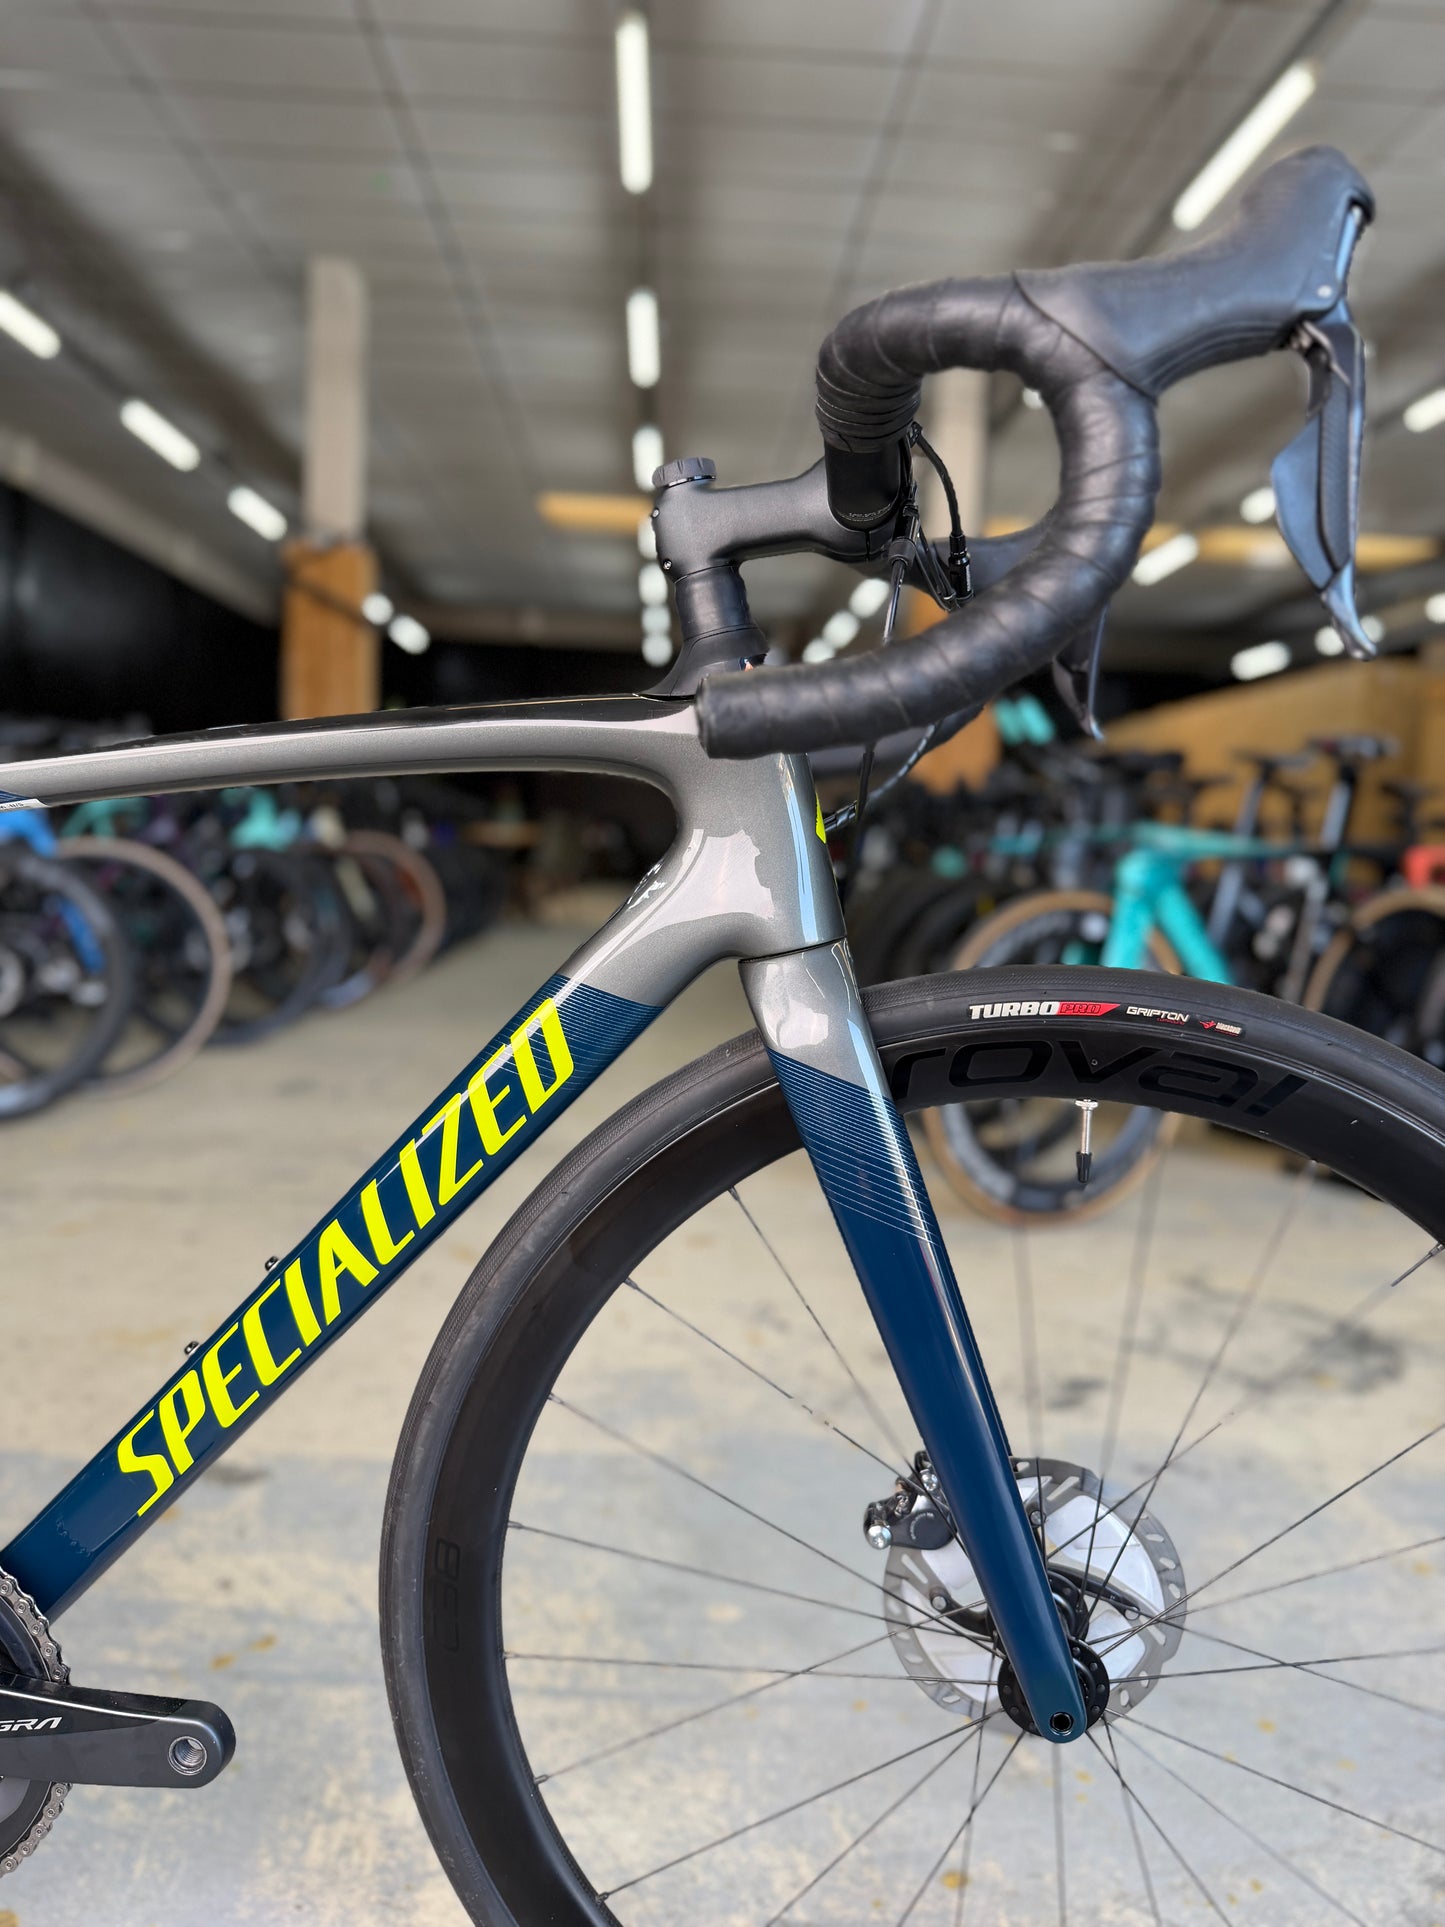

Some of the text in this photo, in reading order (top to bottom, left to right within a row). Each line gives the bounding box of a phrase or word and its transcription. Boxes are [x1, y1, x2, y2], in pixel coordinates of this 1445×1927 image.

[969, 1001, 1060, 1020] TURBO
[1059, 1003, 1102, 1014] PRO
[1126, 1006, 1190, 1022] GRIPTON
[118, 998, 574, 1517] SPECIALIZED
